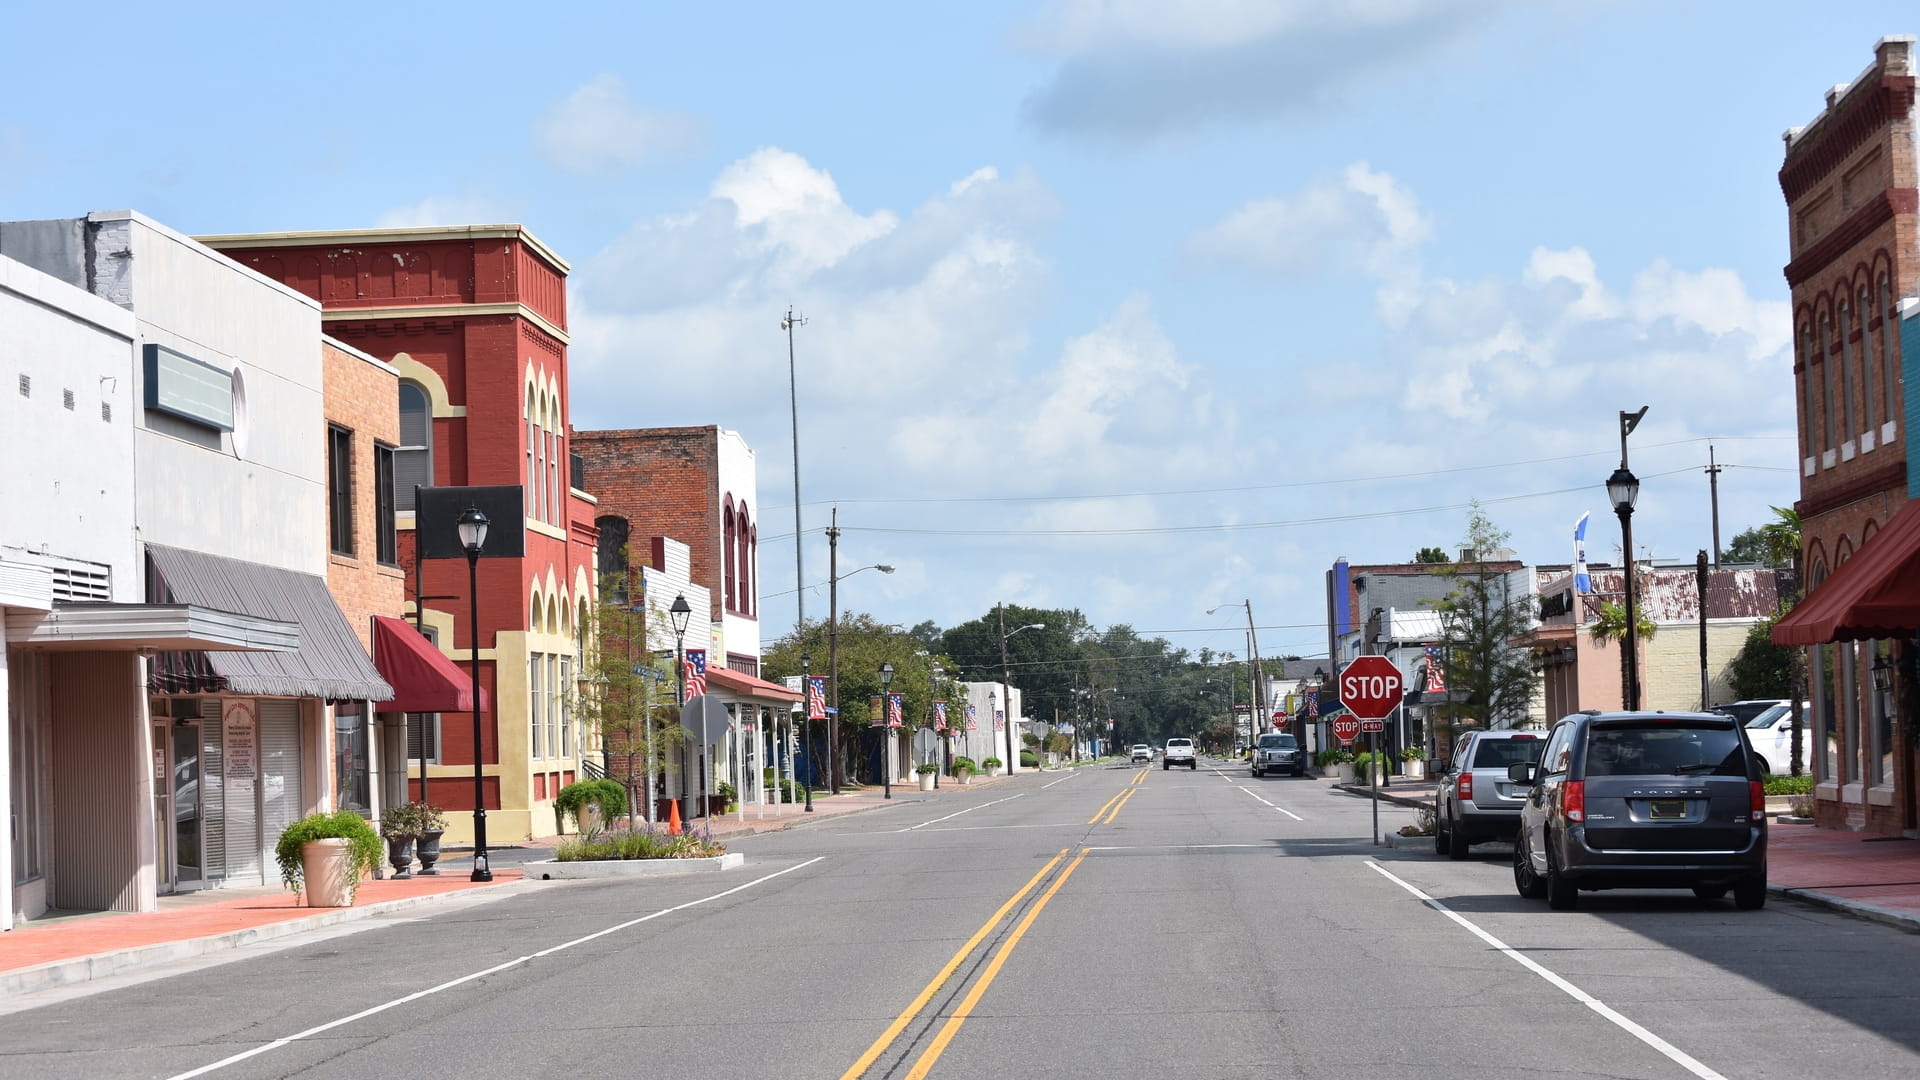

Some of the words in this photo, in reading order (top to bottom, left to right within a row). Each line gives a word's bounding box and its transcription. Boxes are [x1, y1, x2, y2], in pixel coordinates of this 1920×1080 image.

[1344, 675, 1399, 700] STOP
[1272, 716, 1287, 724] STOP
[1335, 721, 1358, 733] STOP
